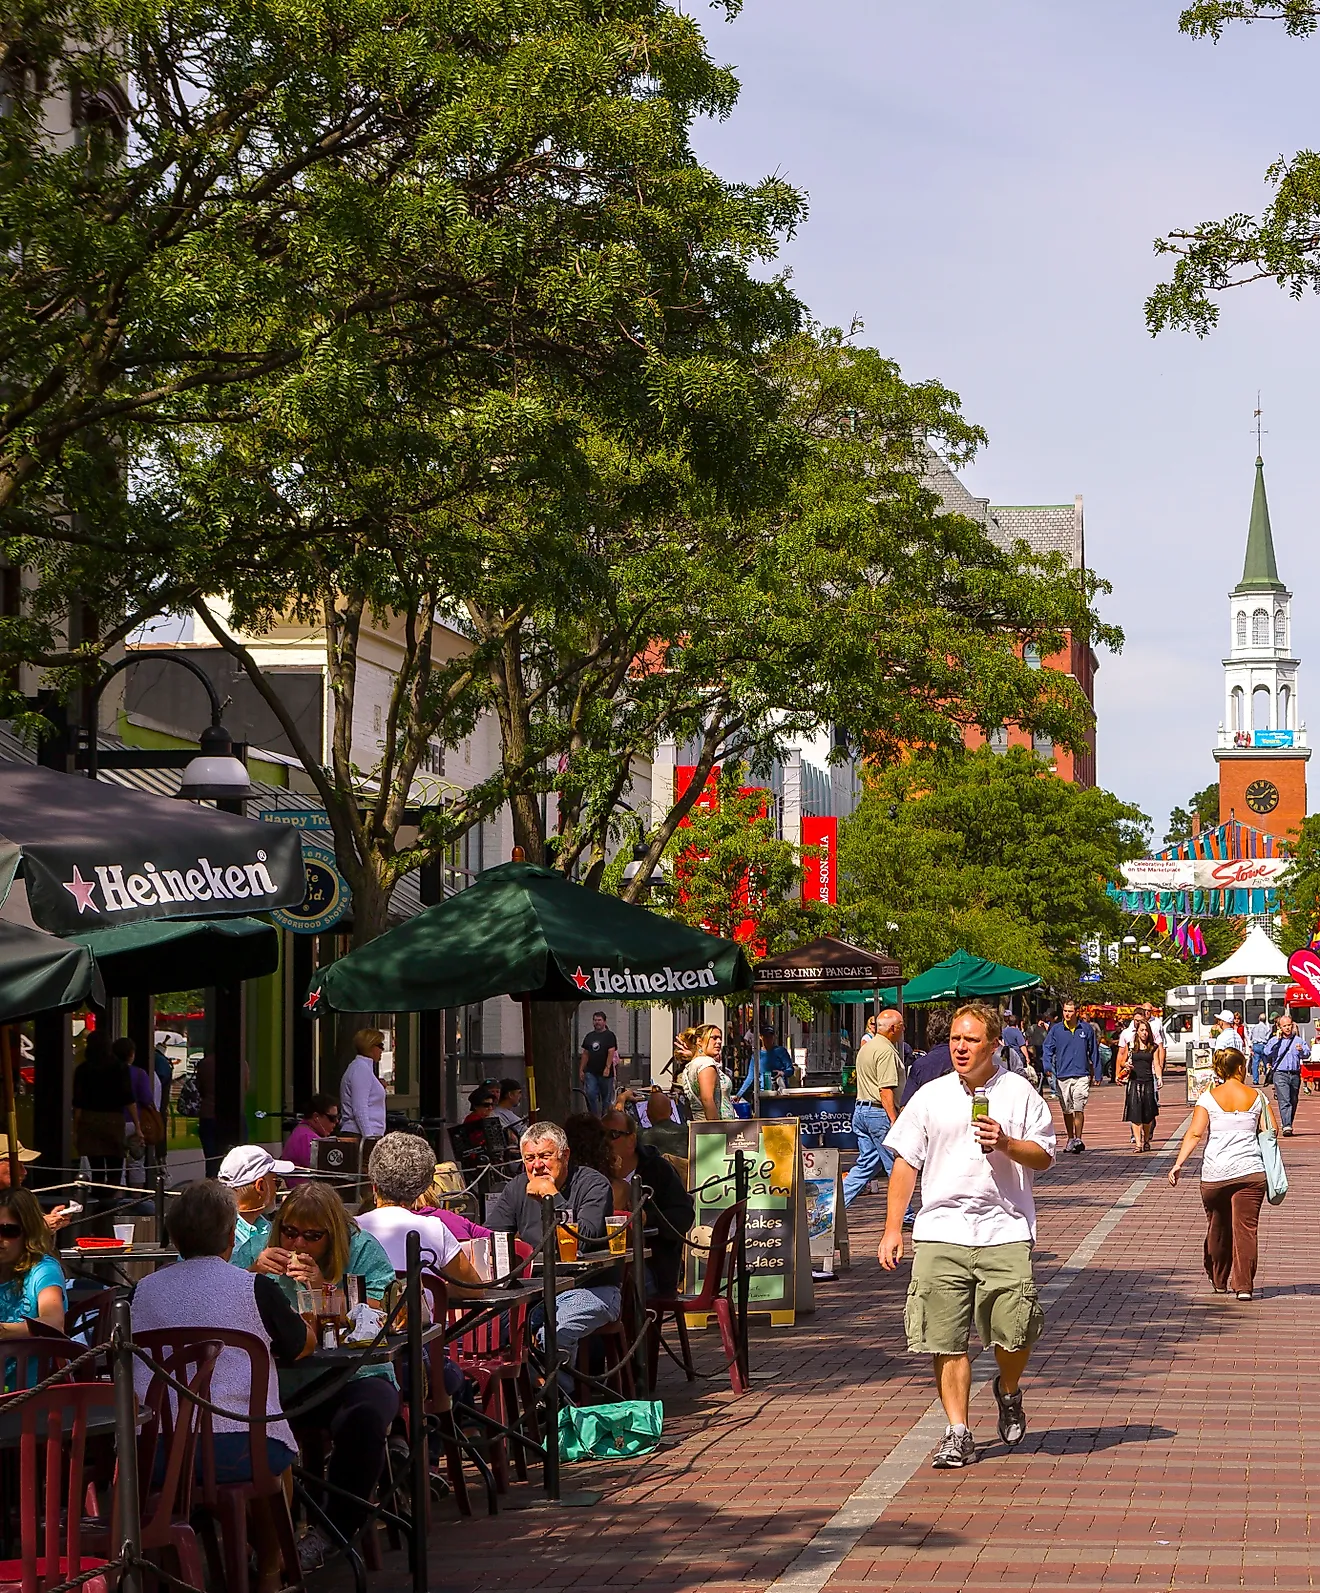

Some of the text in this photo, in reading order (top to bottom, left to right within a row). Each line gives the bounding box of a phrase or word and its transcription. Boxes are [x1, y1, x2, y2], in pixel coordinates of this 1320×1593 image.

[94, 857, 278, 912] Heineken
[592, 966, 718, 994] Heineken
[759, 969, 782, 979] THE
[784, 967, 823, 978] SKINNY
[825, 966, 873, 976] PANCAKE
[820, 1110, 852, 1120] Savory
